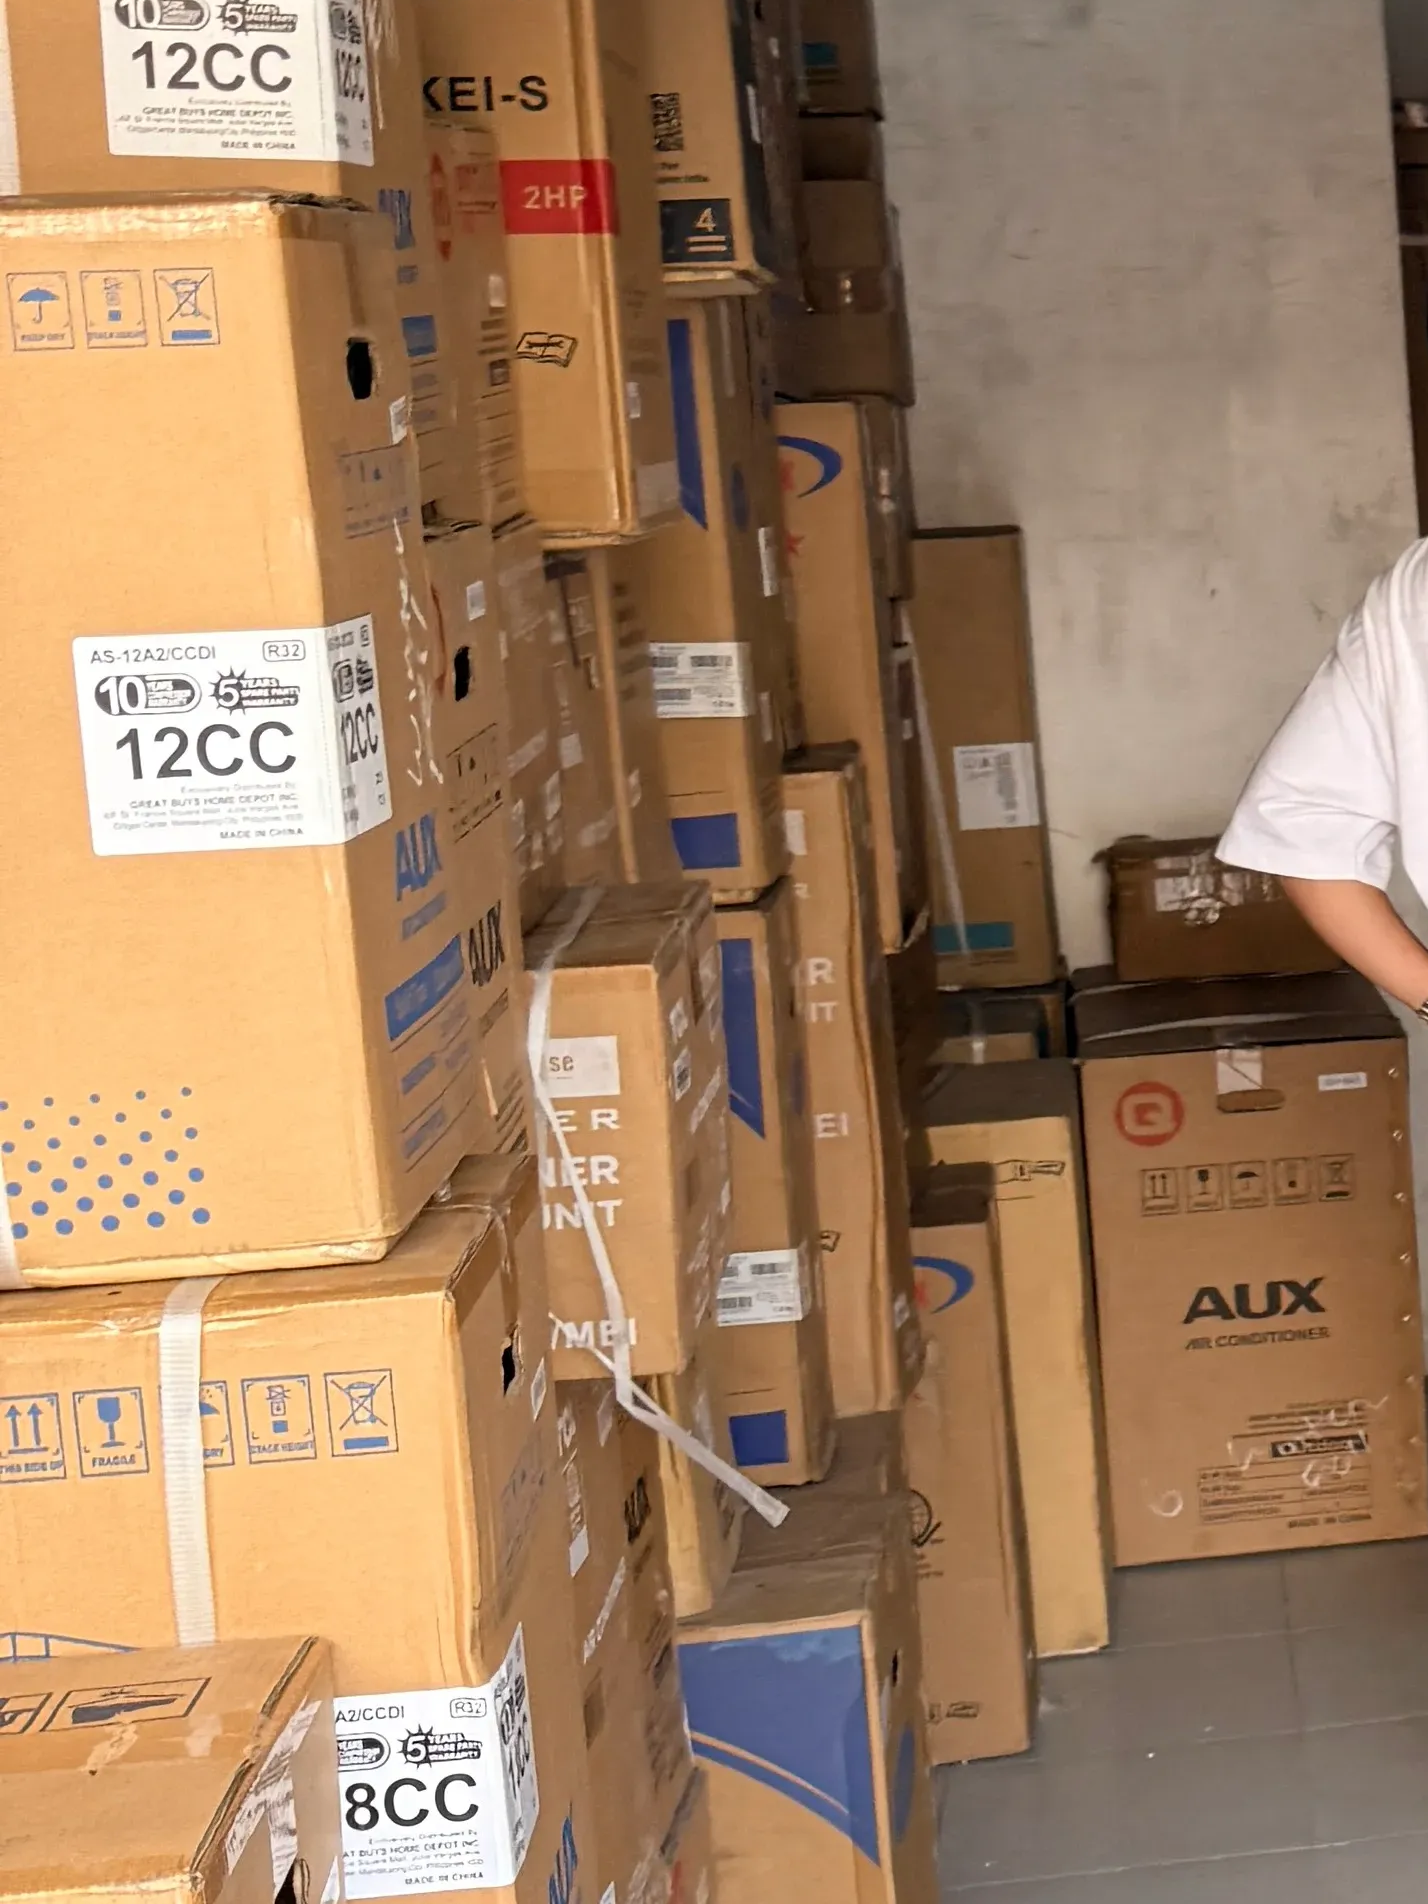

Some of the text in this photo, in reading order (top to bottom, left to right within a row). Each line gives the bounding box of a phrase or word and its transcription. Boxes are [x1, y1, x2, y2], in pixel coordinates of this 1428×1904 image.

[223, 3, 243, 29] 5
[131, 40, 293, 94] 12CC
[522, 185, 587, 210] 2HP
[91, 644, 301, 665] AS-12A2/CCDI R32
[98, 675, 148, 716] 10
[217, 681, 241, 707] 5
[340, 702, 379, 767] 12CC
[116, 720, 297, 781] 12CC
[395, 808, 444, 902] AUX
[1183, 1276, 1326, 1325] AUX
[1215, 1326, 1330, 1348] CONDITIONER
[92, 1454, 136, 1468] FRAGILE
[454, 1700, 483, 1715] R32
[406, 1735, 429, 1763] 5
[345, 1773, 480, 1832] 8CC
